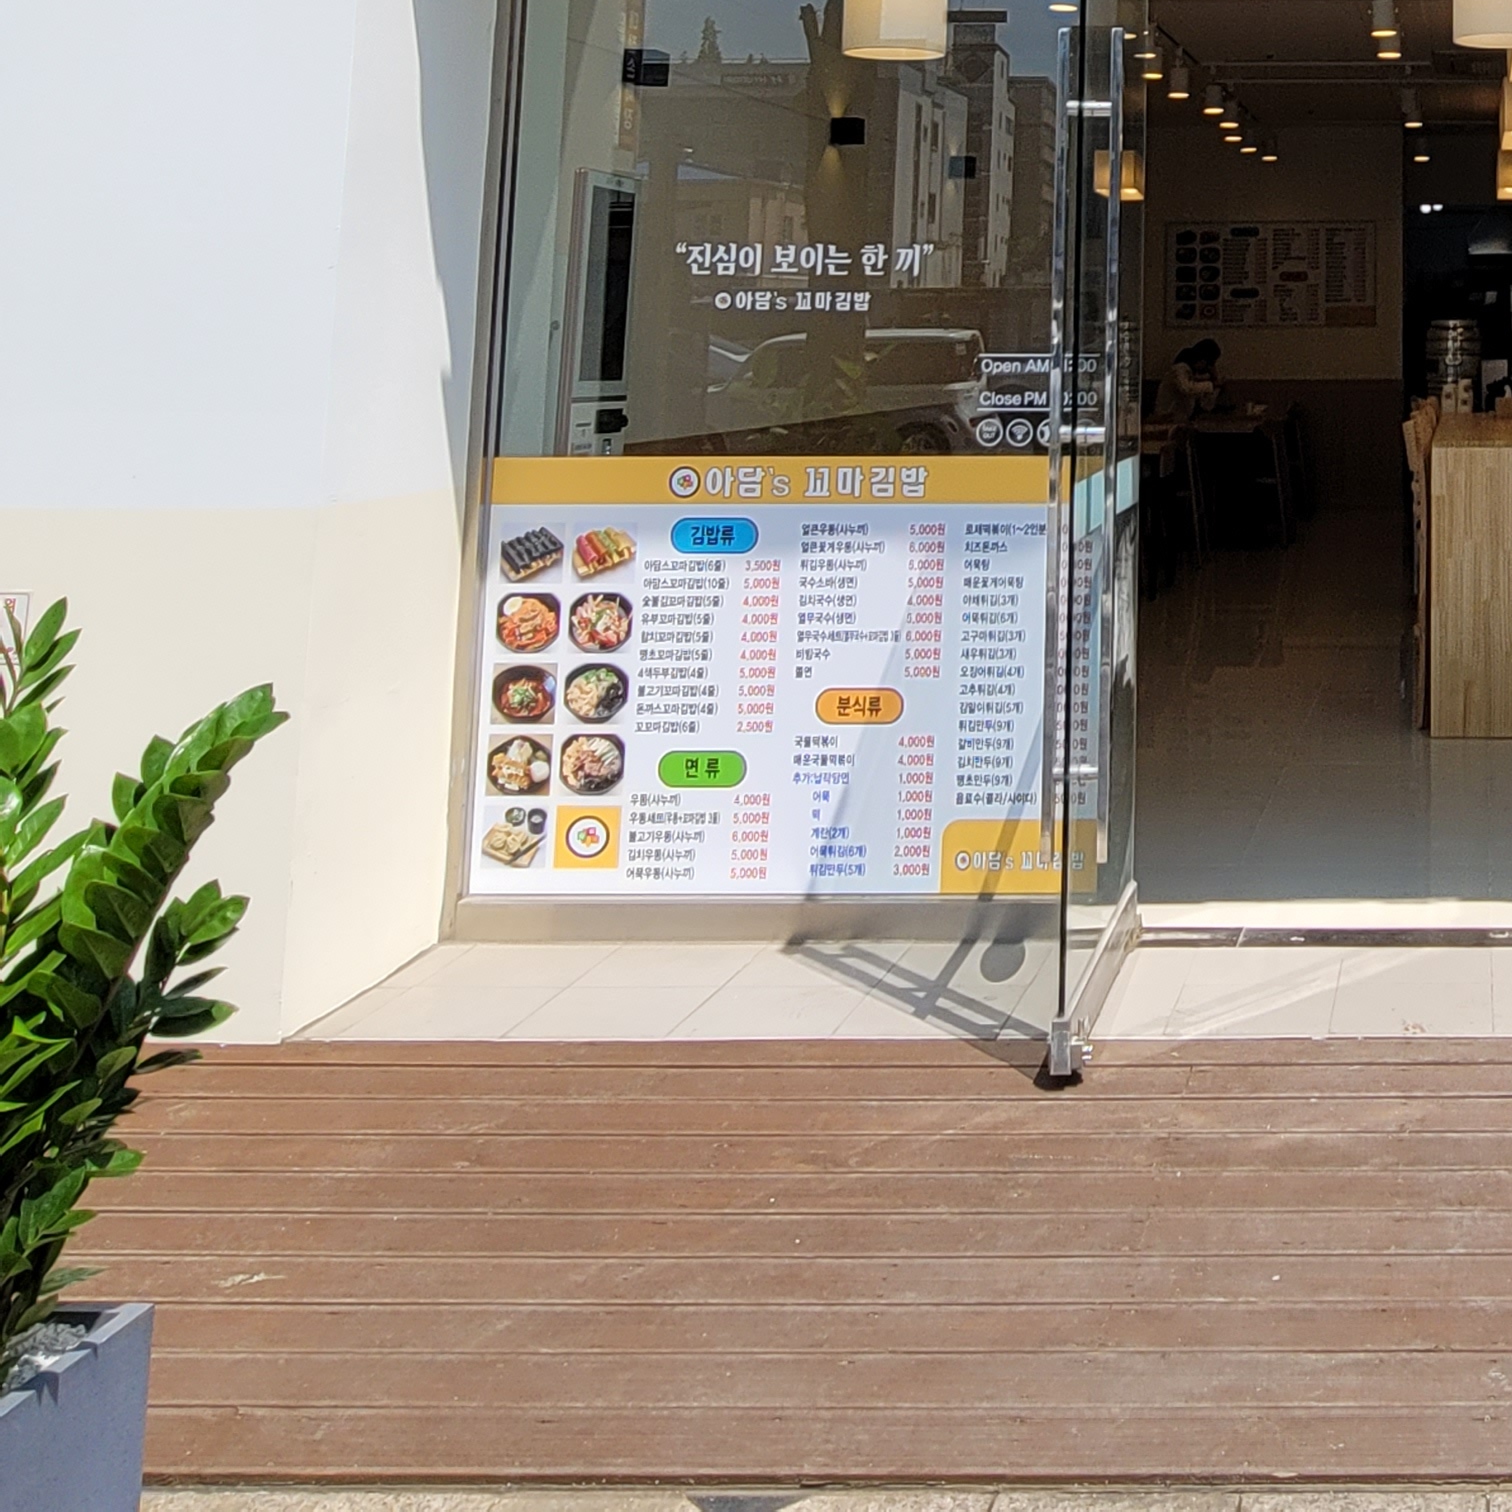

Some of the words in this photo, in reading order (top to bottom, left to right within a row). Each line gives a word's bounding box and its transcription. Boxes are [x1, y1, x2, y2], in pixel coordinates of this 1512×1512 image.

[770, 243, 852, 276] 보이는
[860, 244, 888, 276] 한
[795, 291, 872, 312] 꼬마김밥
[981, 358, 1021, 375] Open
[1025, 358, 1050, 373] AM
[979, 391, 1022, 406] Close
[1024, 391, 1047, 405] PM
[803, 465, 928, 498] 꼬마김밥
[690, 524, 736, 547] 김밥류
[836, 695, 882, 717] 분식류
